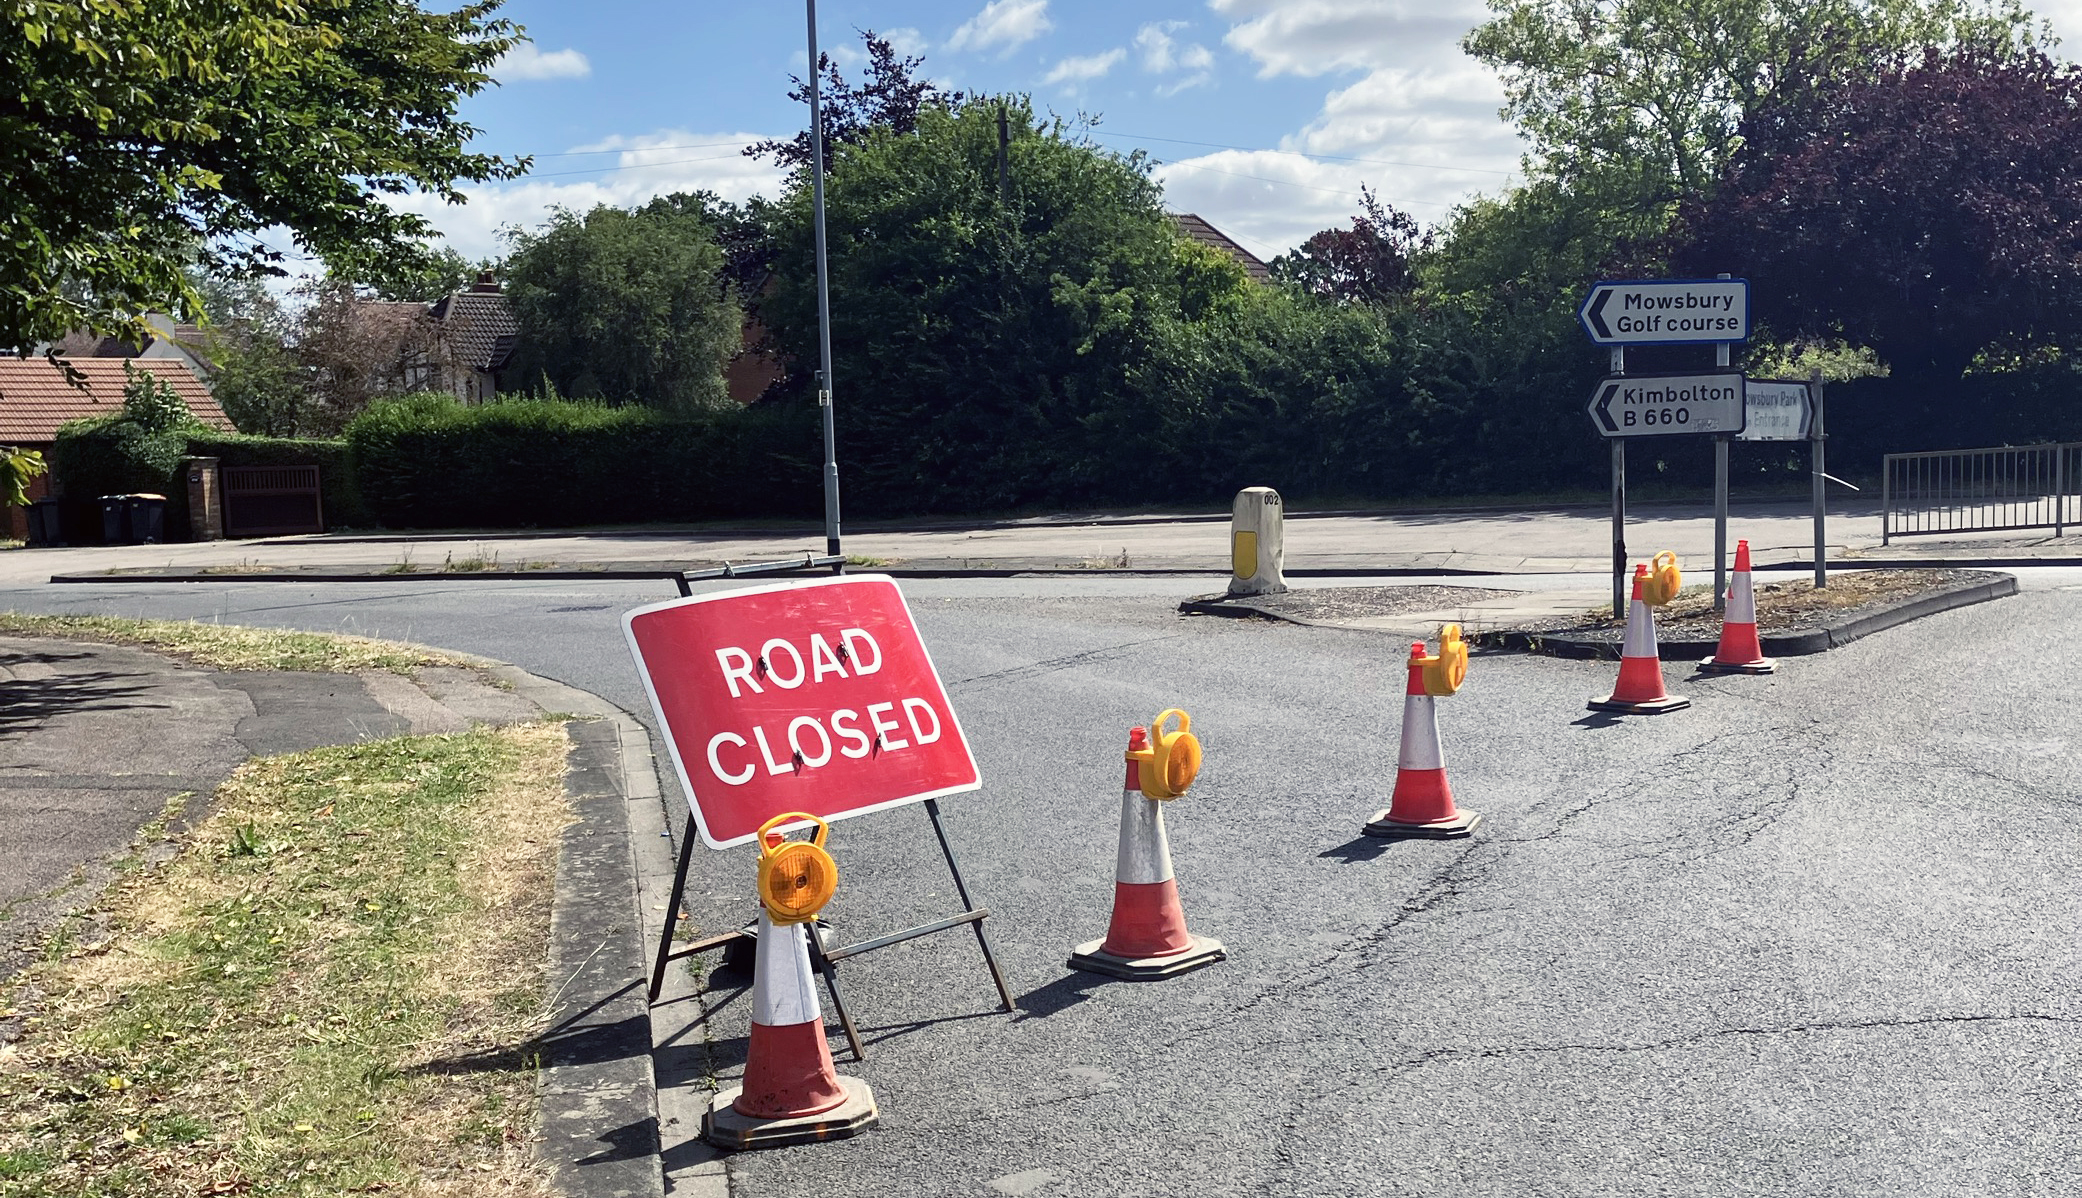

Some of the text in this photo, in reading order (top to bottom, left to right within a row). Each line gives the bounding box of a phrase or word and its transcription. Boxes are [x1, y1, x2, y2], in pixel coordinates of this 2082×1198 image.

[1624, 292, 1734, 312] Mowsbury
[1617, 315, 1739, 333] Golf course
[1623, 385, 1735, 405] Kimbolton
[1746, 390, 1798, 409] owsbury Park
[1623, 410, 1637, 427] B
[1644, 407, 1690, 426] 660
[1264, 494, 1279, 506] 002
[714, 627, 883, 698] ROAD
[706, 697, 942, 786] CLOSED
